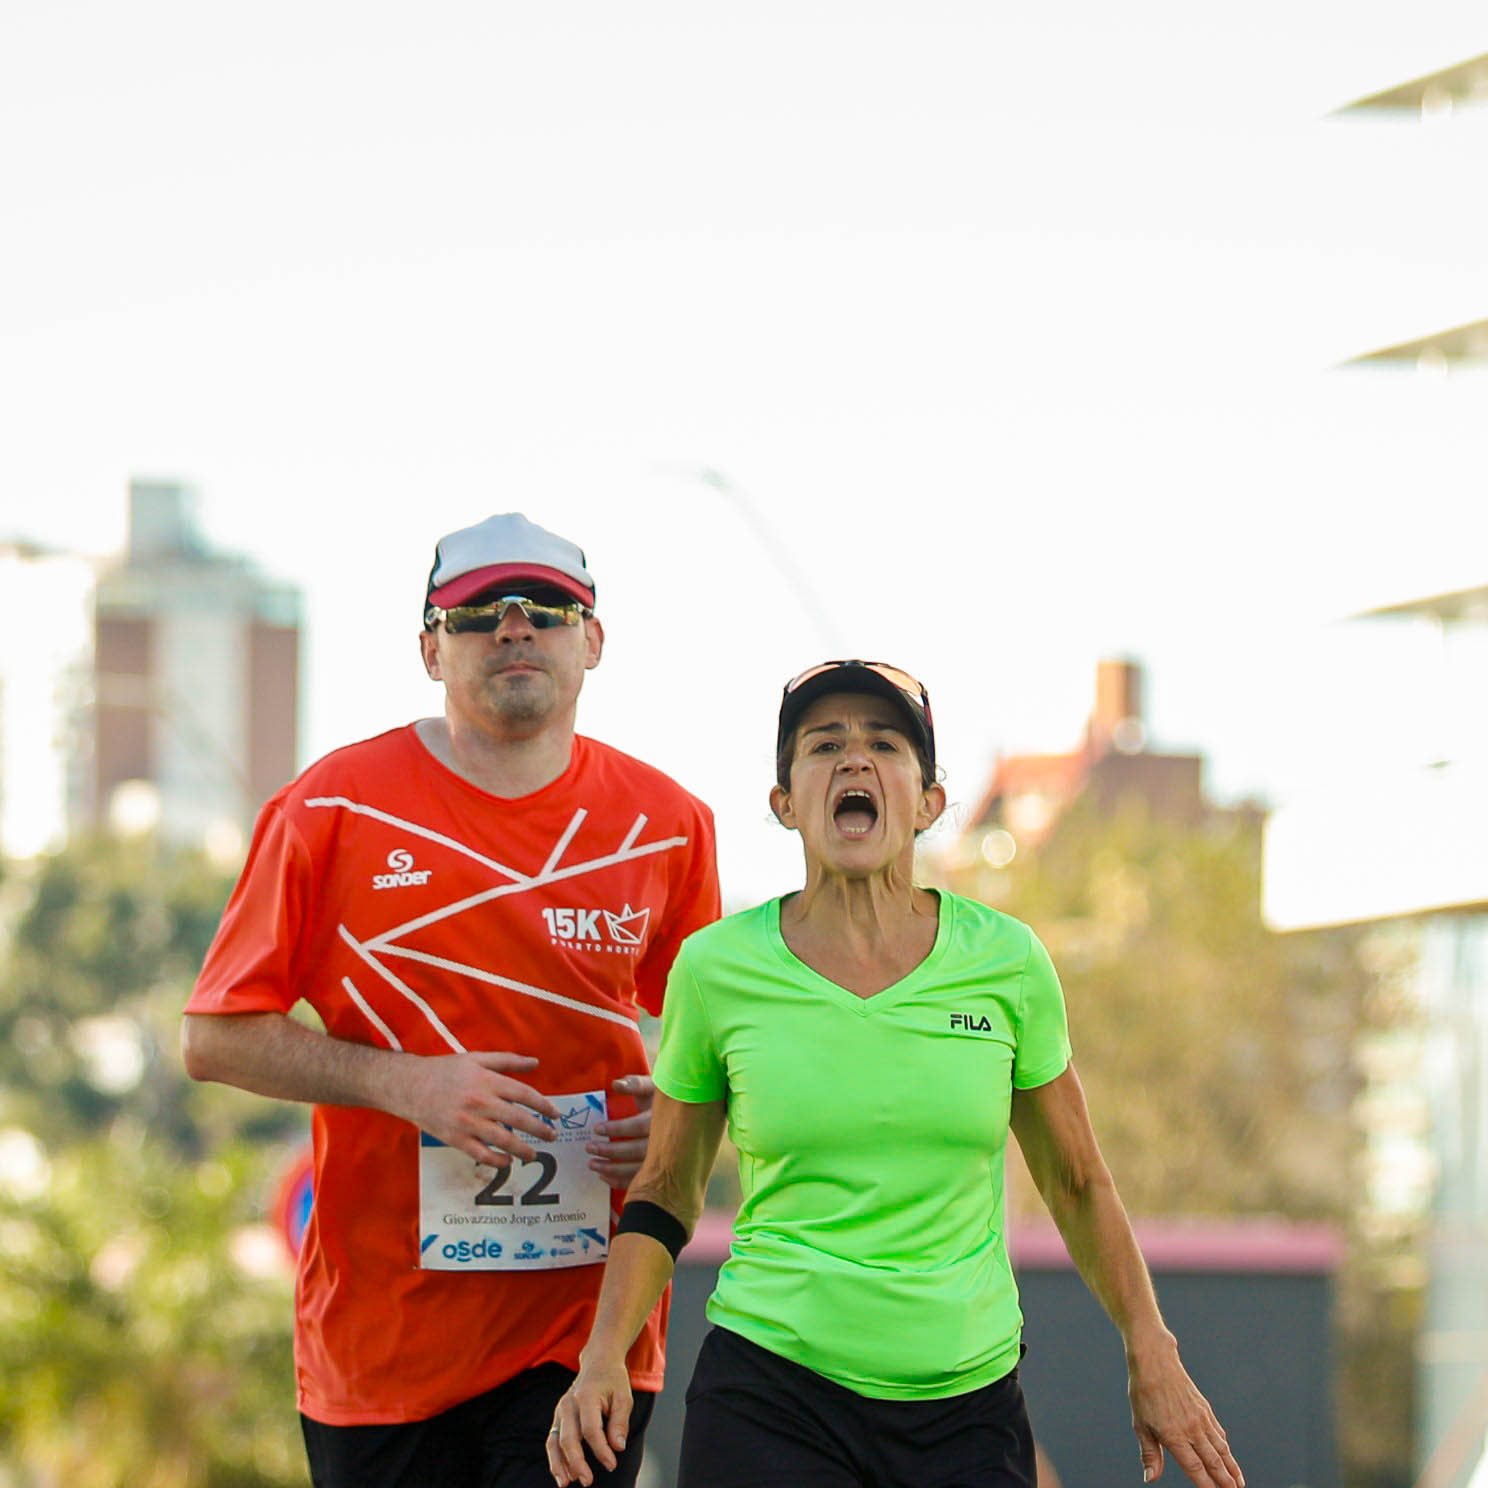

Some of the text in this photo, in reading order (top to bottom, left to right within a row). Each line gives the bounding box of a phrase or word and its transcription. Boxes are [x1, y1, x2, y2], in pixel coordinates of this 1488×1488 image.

[542, 907, 601, 941] 15K
[950, 1013, 992, 1031] FILA
[474, 1151, 560, 1207] 22
[442, 1209, 587, 1227] Giovazzino Jorge Antonio
[442, 1239, 503, 1262] osde
